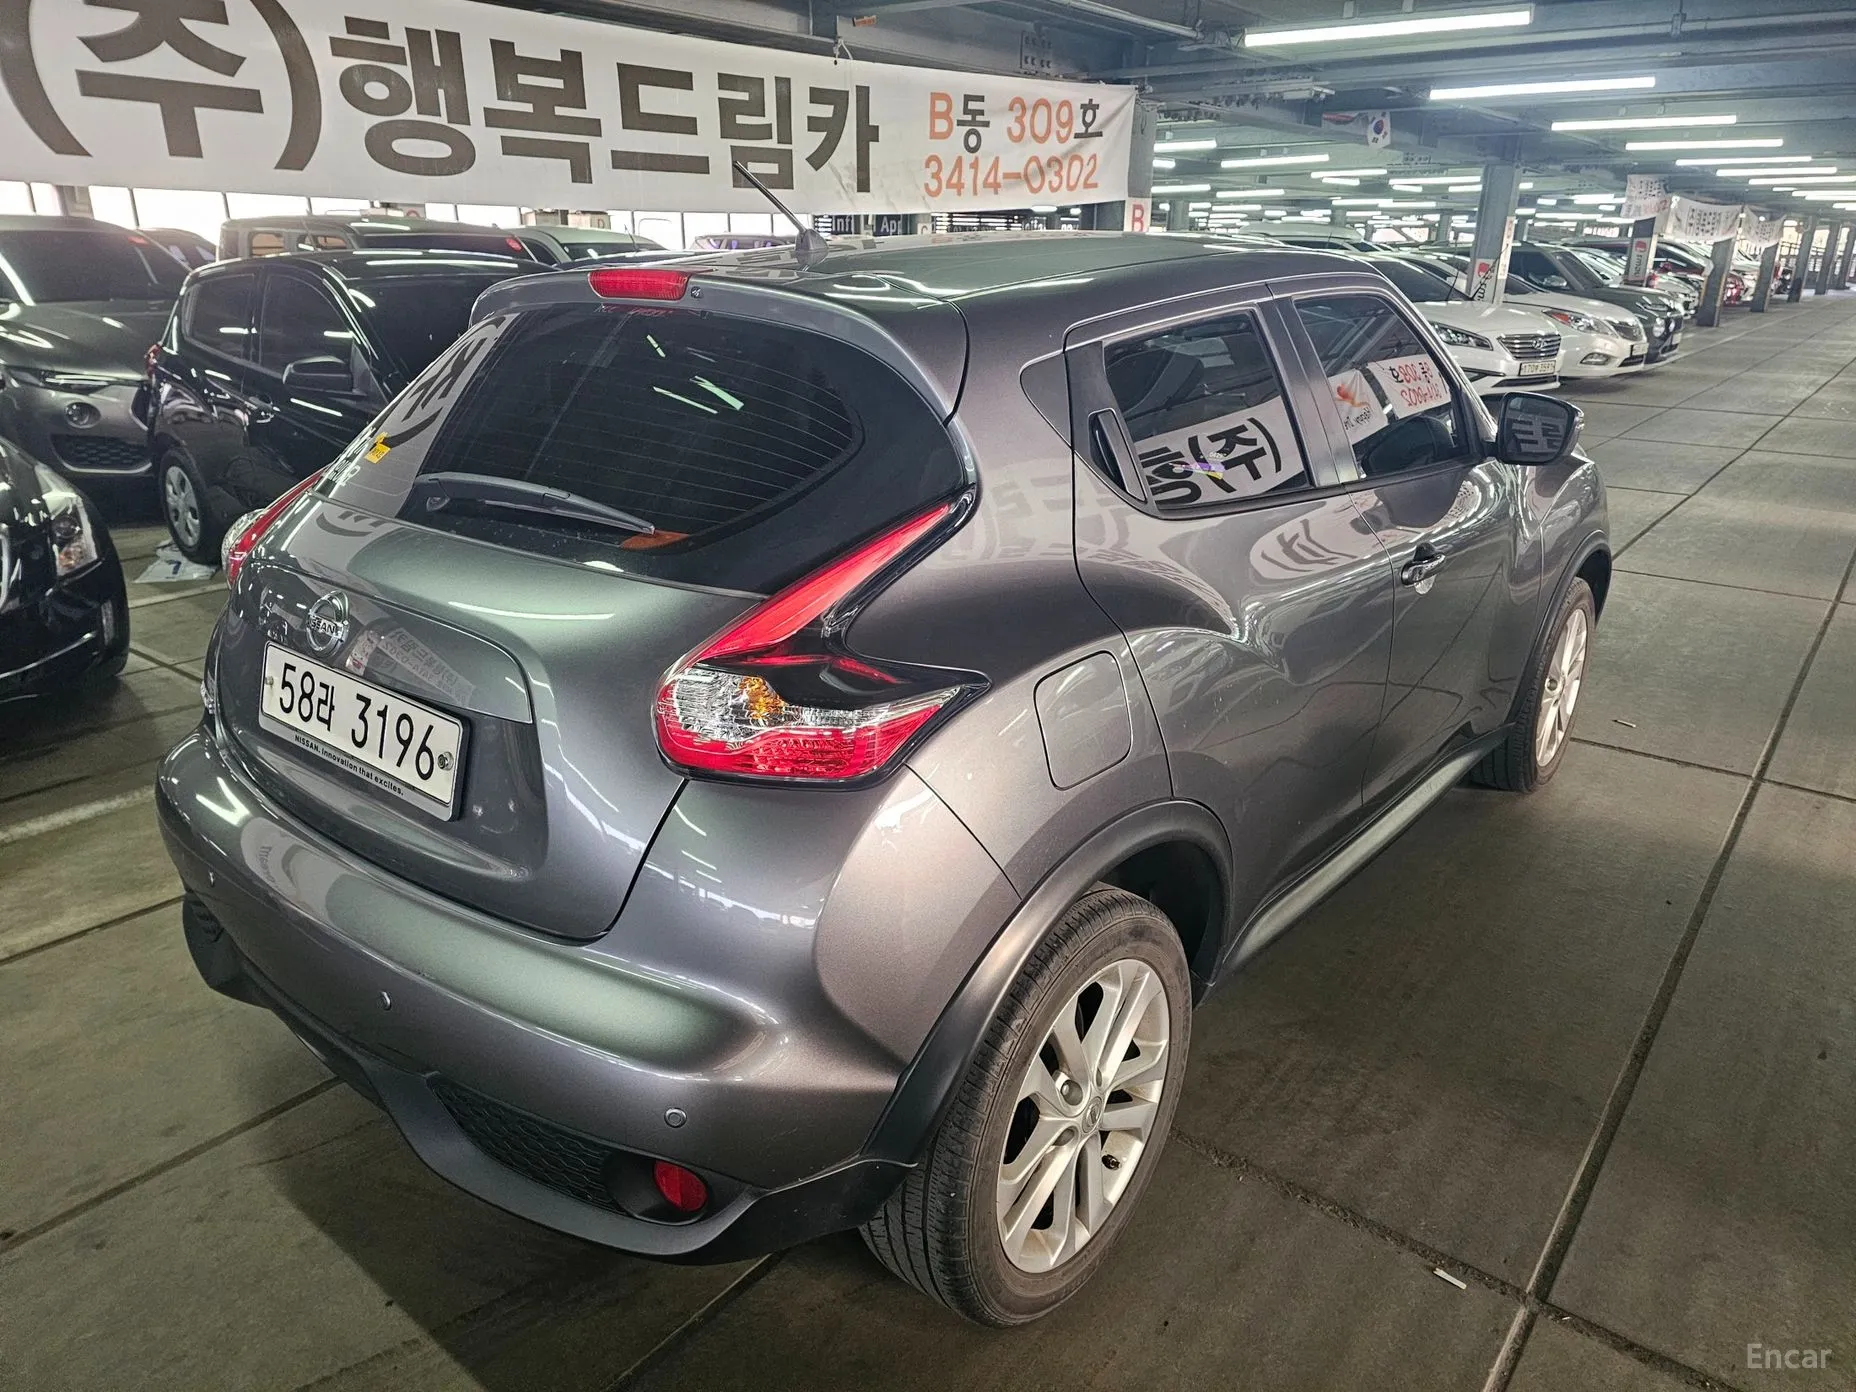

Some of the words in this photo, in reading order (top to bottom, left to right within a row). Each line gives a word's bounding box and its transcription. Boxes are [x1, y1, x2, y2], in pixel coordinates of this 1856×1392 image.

[929, 91, 990, 154] B동
[1006, 96, 1103, 144] 309호
[923, 153, 1099, 198] 3414-0302
[279, 662, 336, 732] 58라
[351, 692, 435, 781] 3196
[359, 766, 373, 780] that
[374, 776, 404, 796] excites.
